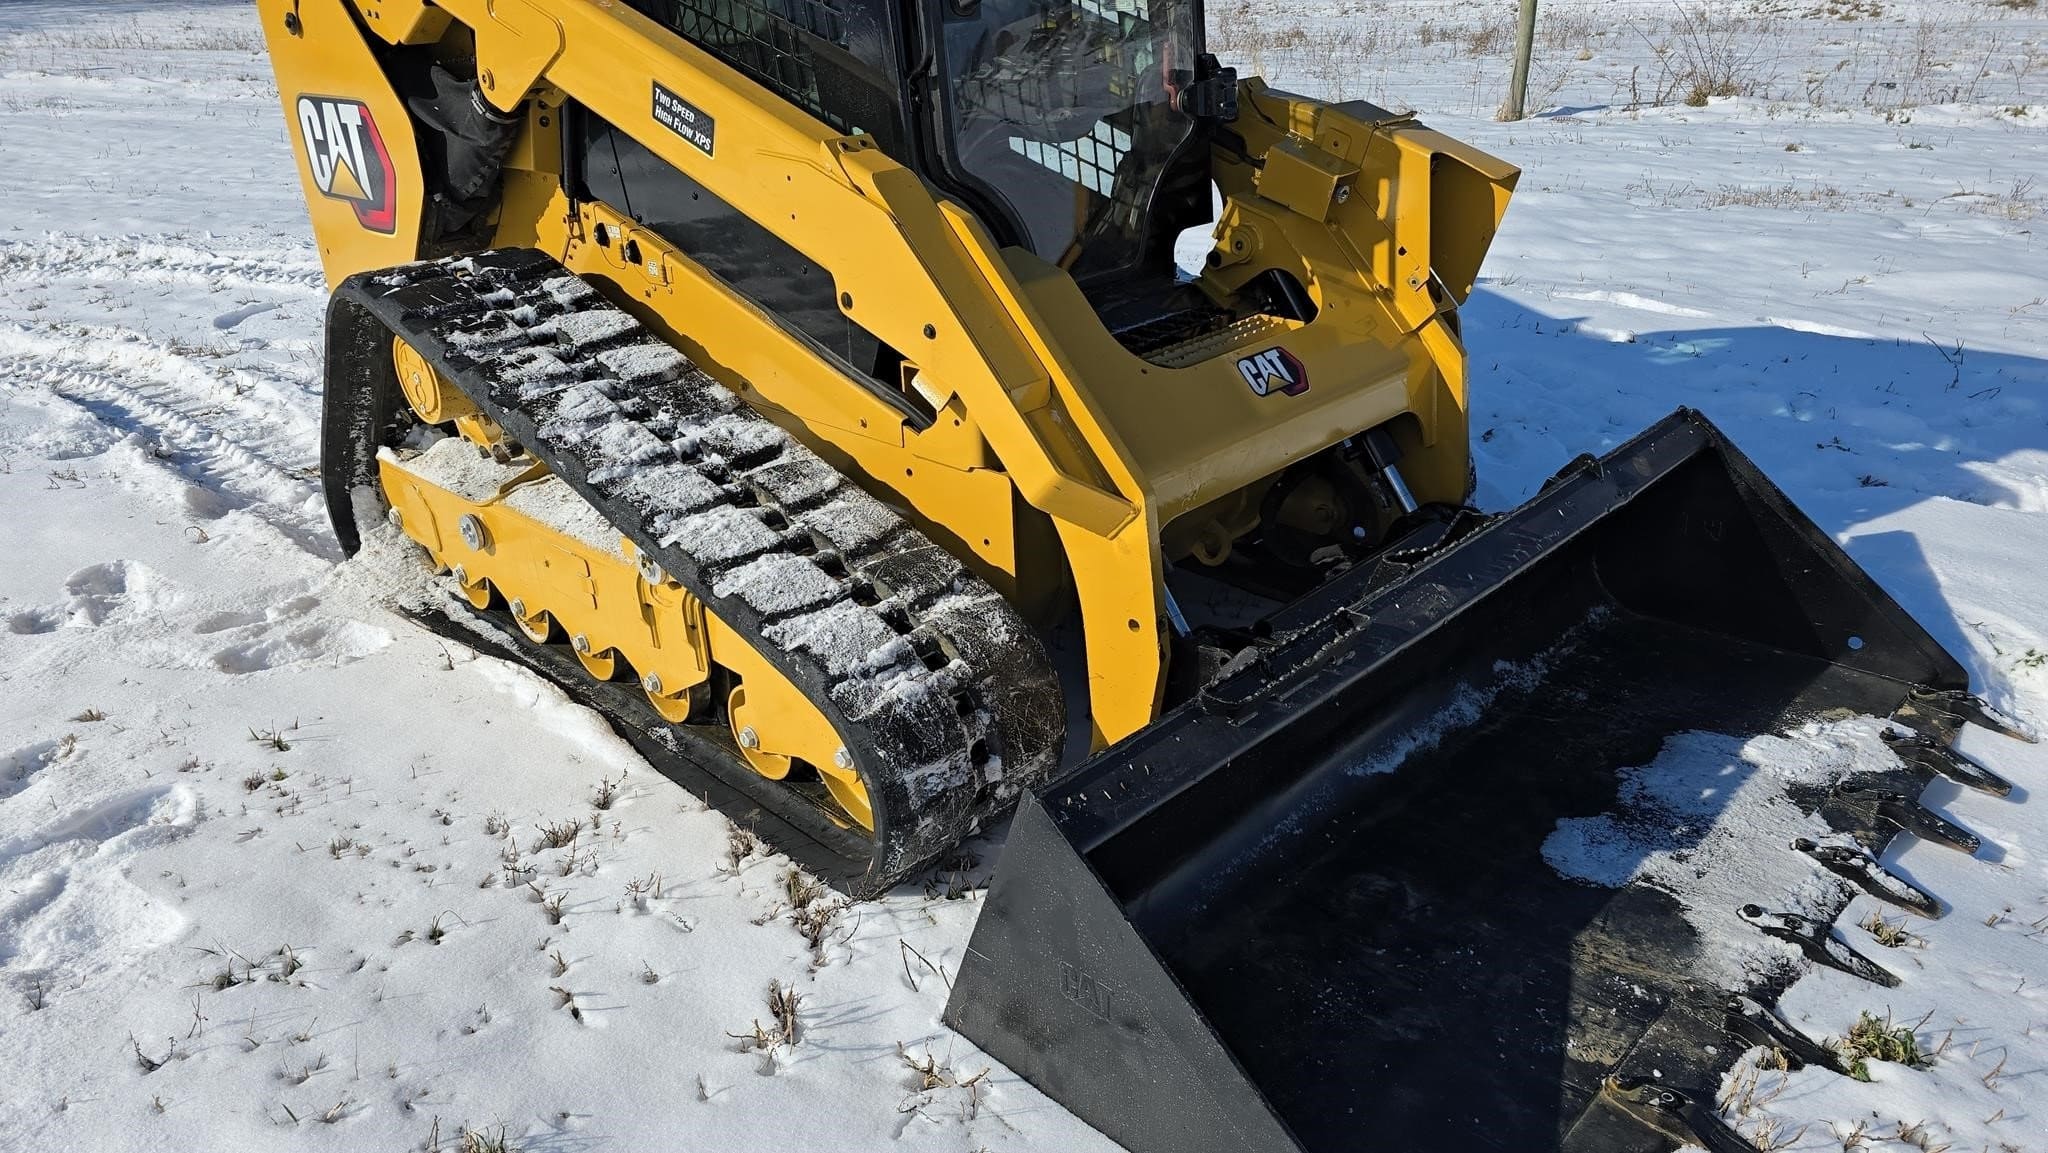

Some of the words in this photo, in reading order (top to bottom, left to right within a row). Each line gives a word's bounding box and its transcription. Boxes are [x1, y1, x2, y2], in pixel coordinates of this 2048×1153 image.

[655, 87, 671, 108] TWO
[671, 99, 695, 123] SPEED
[655, 104, 673, 126] HIGH
[673, 117, 693, 139] FLOW
[694, 130, 711, 151] XPS
[299, 98, 374, 200] CAT
[1238, 348, 1295, 395] CAT
[1059, 960, 1113, 1021] CAT
